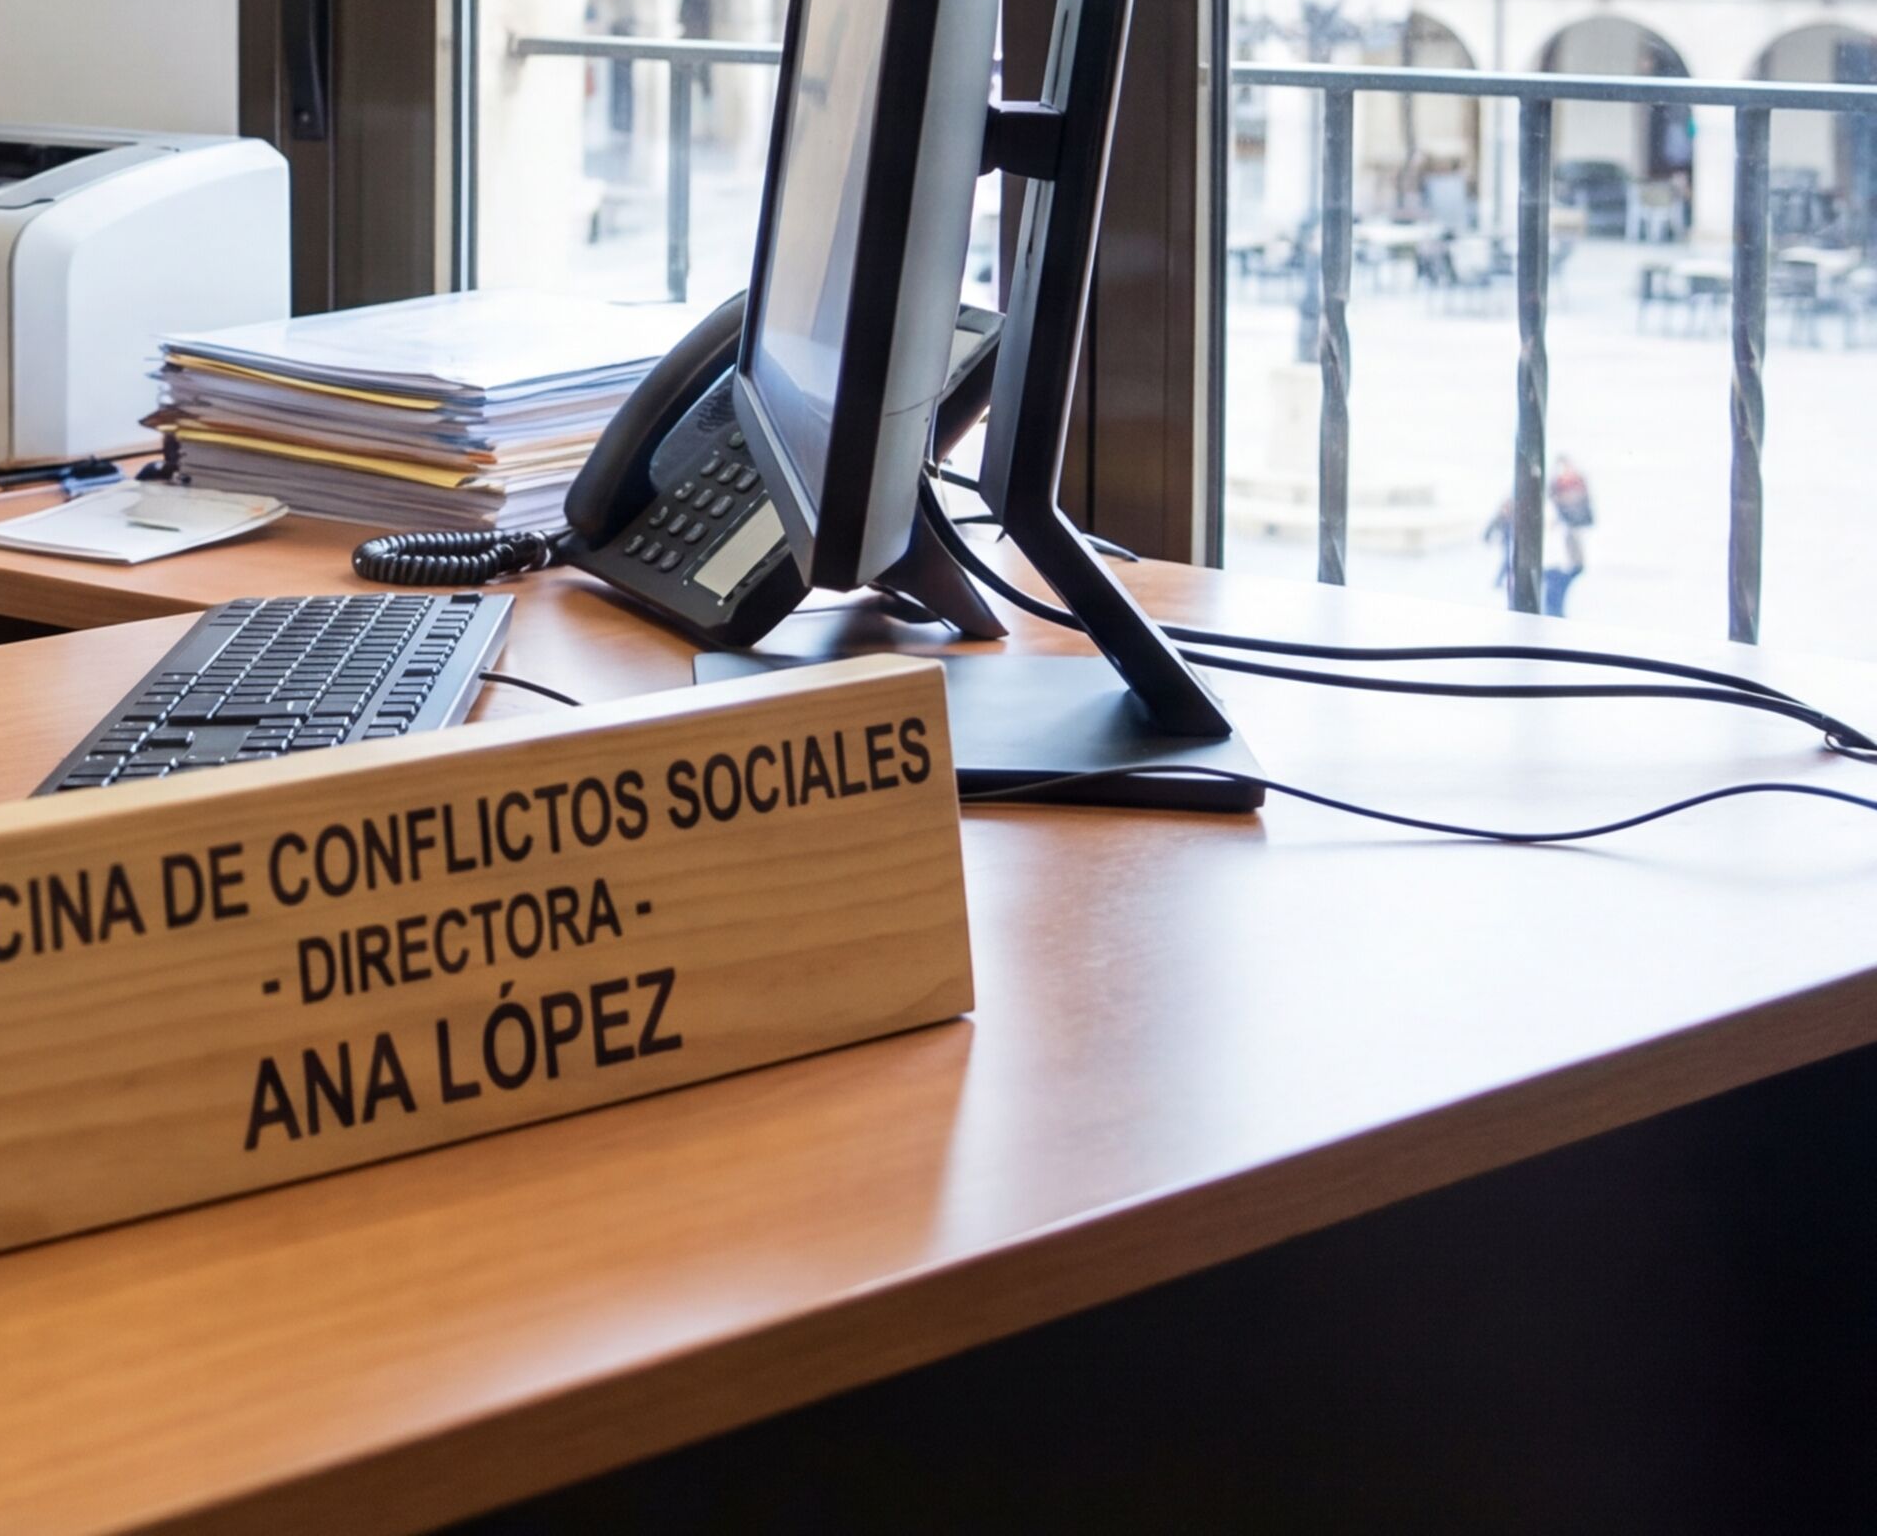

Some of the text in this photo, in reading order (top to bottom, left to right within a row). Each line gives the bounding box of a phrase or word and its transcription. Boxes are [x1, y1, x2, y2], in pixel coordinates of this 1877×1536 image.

[161, 843, 249, 932] DE
[265, 766, 651, 910] CONFLICTOS
[665, 715, 934, 834] SOCIALES
[296, 876, 624, 1007] DIRECTORA
[242, 966, 684, 1154] ANA LÓPEZ
